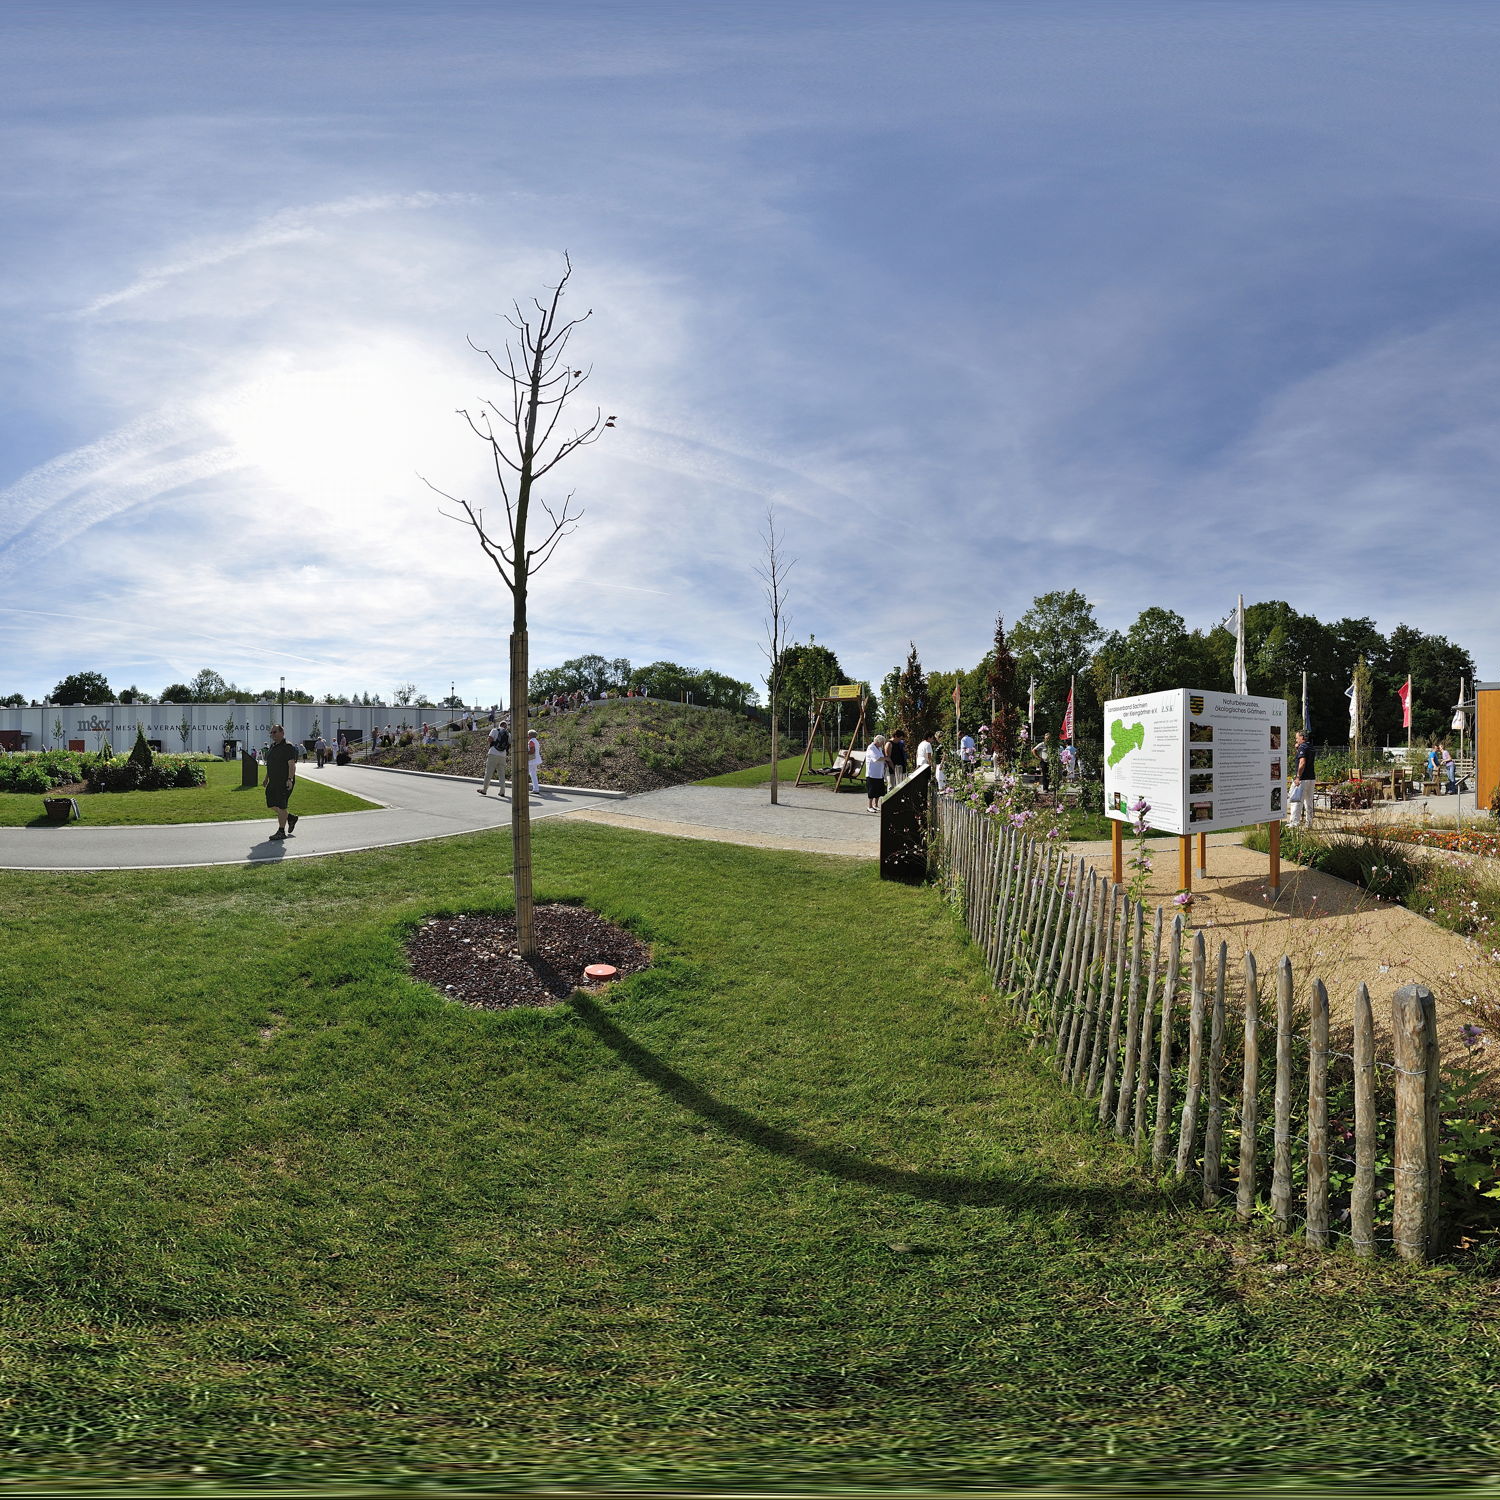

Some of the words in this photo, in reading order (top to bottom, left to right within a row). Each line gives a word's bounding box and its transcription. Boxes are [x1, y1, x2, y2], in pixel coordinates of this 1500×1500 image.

[1215, 705, 1247, 714] ökologisches
[1247, 708, 1267, 716] Gärtnern
[77, 715, 110, 732] m&v
[116, 724, 140, 732] MESS
